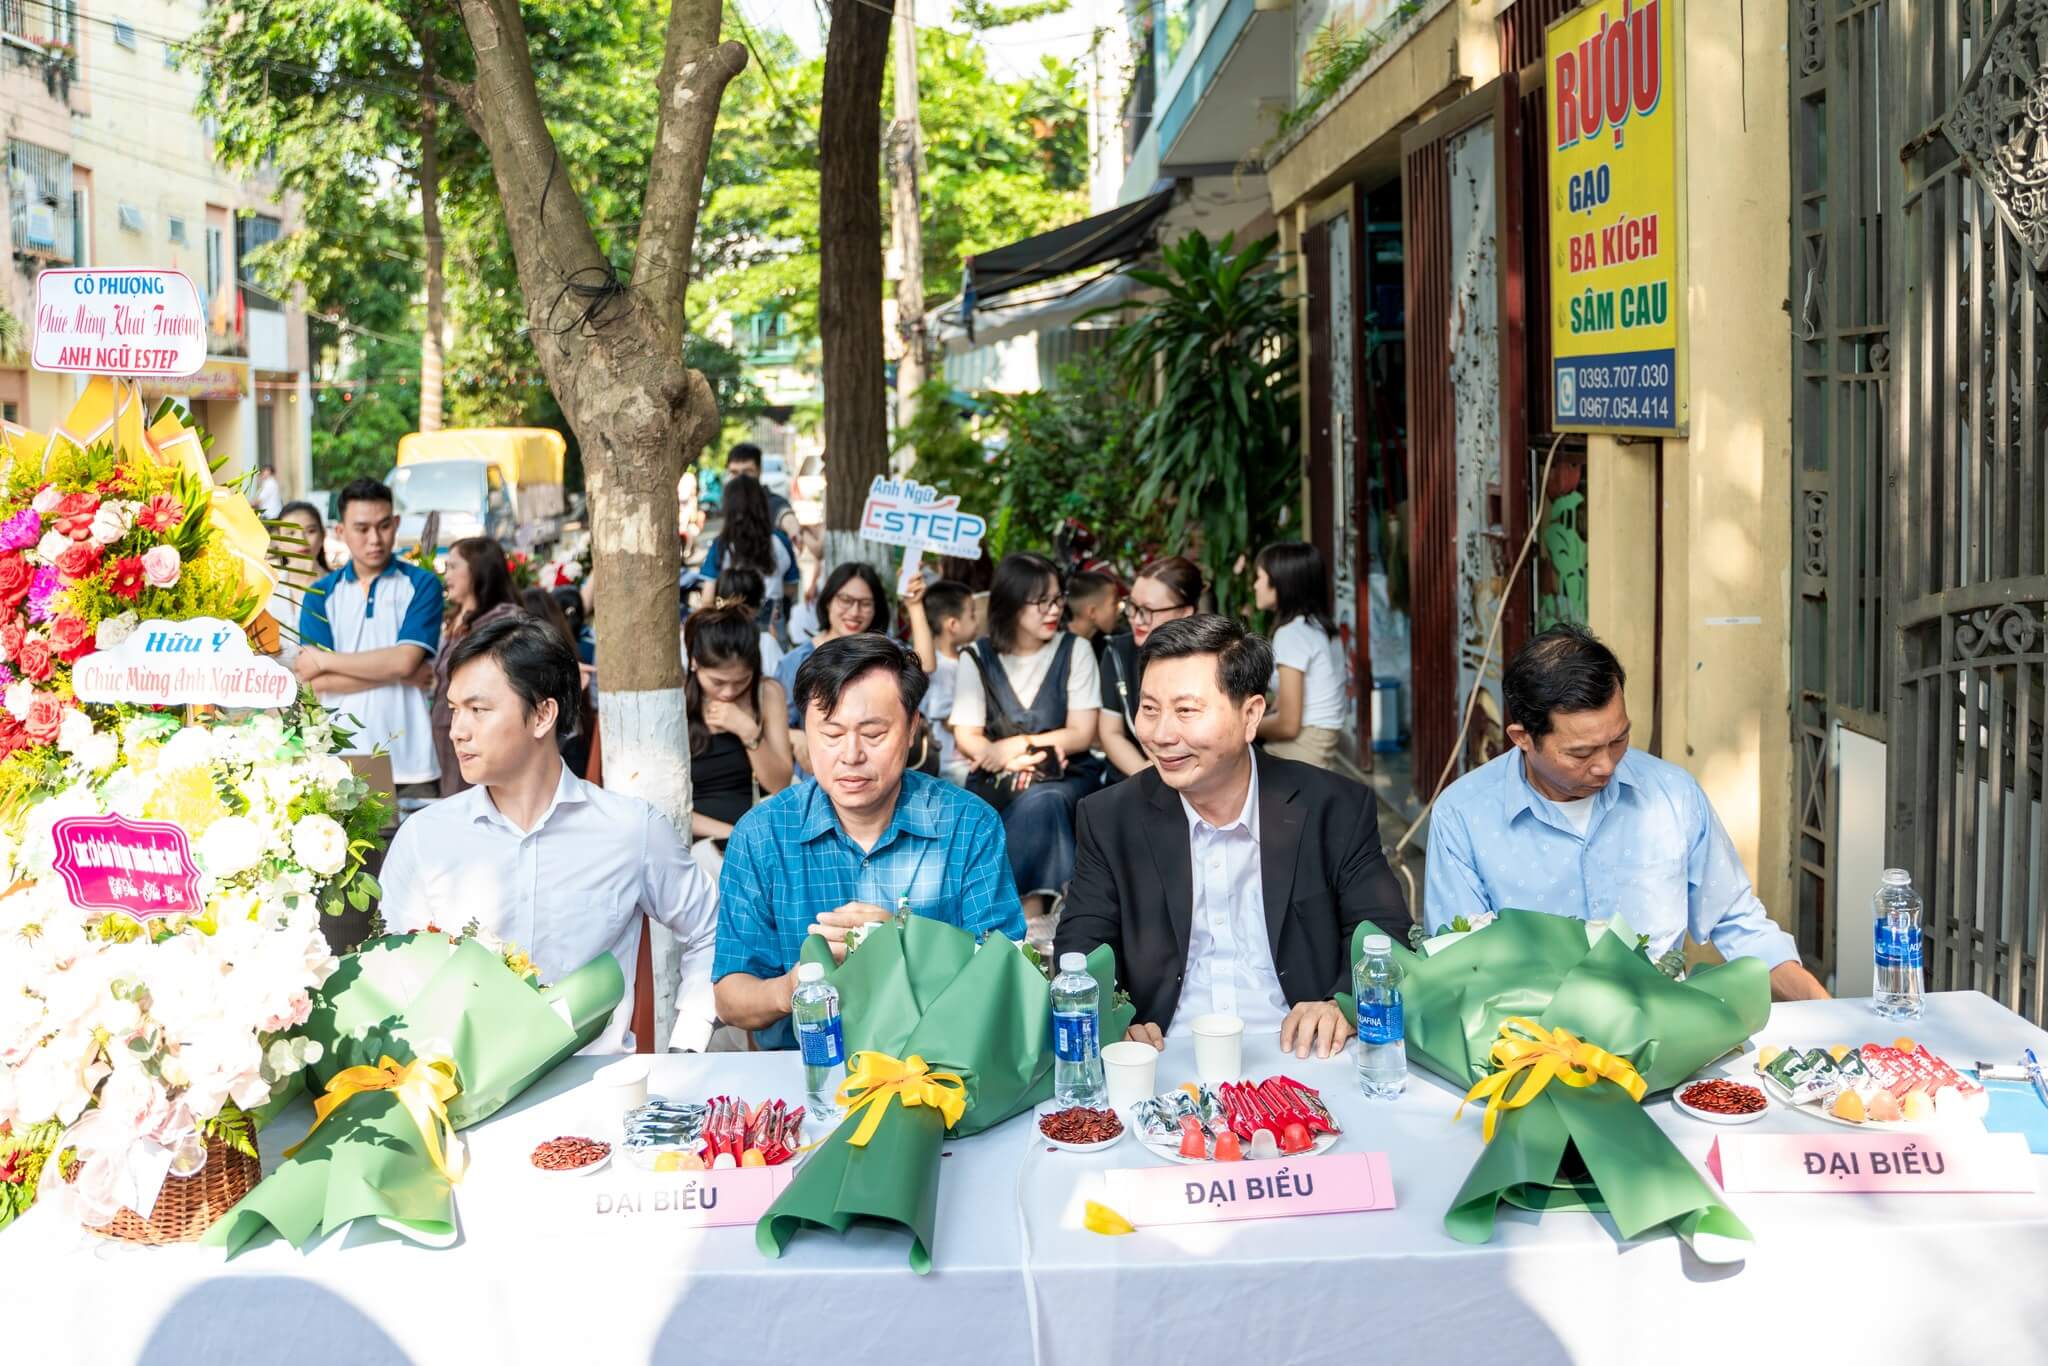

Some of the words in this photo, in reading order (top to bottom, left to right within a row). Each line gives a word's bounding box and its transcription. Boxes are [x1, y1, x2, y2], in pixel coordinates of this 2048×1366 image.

[1555, 0, 1661, 151] RƯỢU
[1569, 164, 1610, 215] GẠO
[1569, 232, 1597, 273] BA
[1602, 215, 1658, 267] KÍCH
[74, 274, 95, 295] CÔ
[99, 274, 165, 298] PHƯỢNG
[39, 304, 69, 334] Chúc
[111, 304, 146, 336] Khai
[1570, 288, 1614, 334] SÂM
[1620, 281, 1668, 328] CAU
[58, 346, 92, 367] ANH
[96, 344, 132, 368] NGỮ
[134, 349, 179, 369] ESTEP
[1579, 363, 1669, 389] 0393.707.030
[1579, 396, 1669, 419] 0967.054.414
[873, 478, 900, 497] Anh
[864, 501, 983, 543] ESTEP
[145, 631, 203, 653] Hữu
[211, 626, 232, 652] Ý
[84, 665, 123, 693] Chúc
[126, 665, 171, 698] Mừng
[174, 666, 206, 693] Anh
[211, 667, 243, 699] Ngữ
[244, 667, 288, 700] Estep
[1804, 1151, 1860, 1180] ĐẠI
[1869, 1143, 1945, 1175] BIỂU
[595, 1190, 642, 1218] ĐẠI
[654, 1180, 718, 1212] BIỂU
[1185, 1179, 1237, 1208] ĐẠI
[1246, 1166, 1314, 1201] BIỂU
